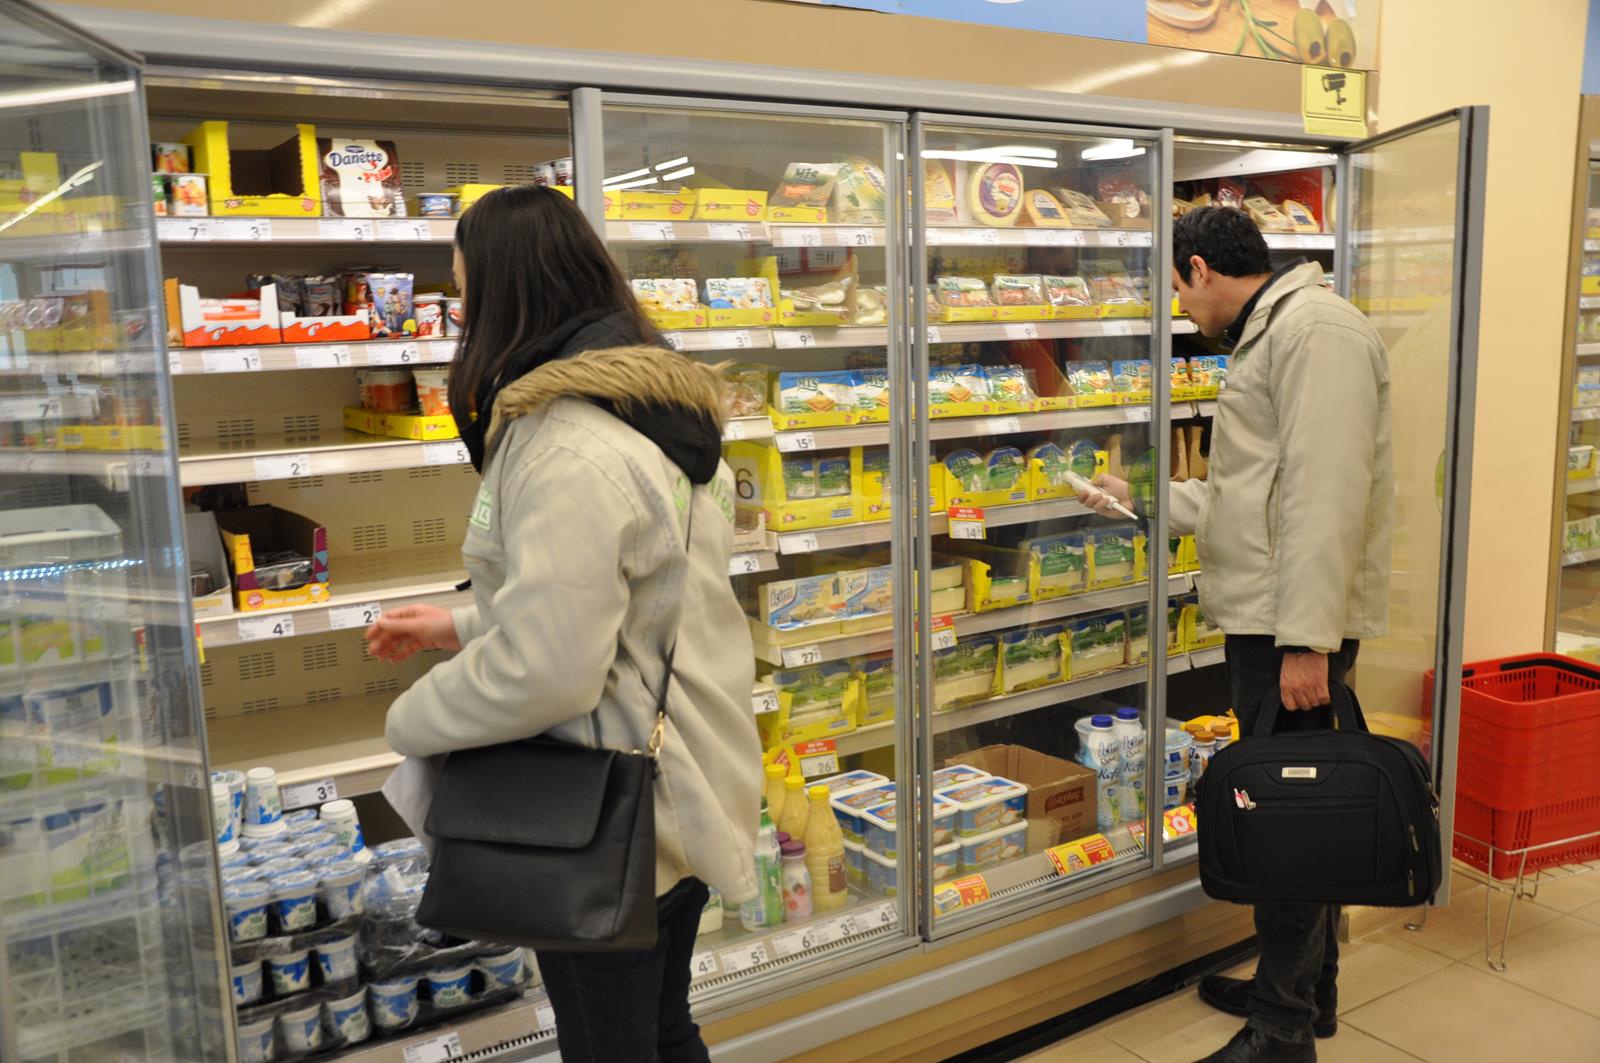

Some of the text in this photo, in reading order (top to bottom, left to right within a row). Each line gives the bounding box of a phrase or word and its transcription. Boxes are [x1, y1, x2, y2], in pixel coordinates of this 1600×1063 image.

[329, 151, 383, 167] Danette
[189, 226, 198, 240] 7
[401, 349, 410, 362] 6
[457, 449, 466, 462] 5
[291, 463, 301, 476] 2
[735, 467, 755, 500] 6
[744, 560, 753, 572] 2
[363, 610, 374, 624] 2
[273, 623, 284, 636] 4
[801, 652, 814, 664] 27
[763, 699, 771, 710] 2
[317, 787, 328, 800] 3
[880, 910, 890, 923] 4
[840, 924, 850, 936] 3
[802, 935, 811, 948] 6
[751, 951, 760, 964] 5
[698, 961, 708, 974] 4
